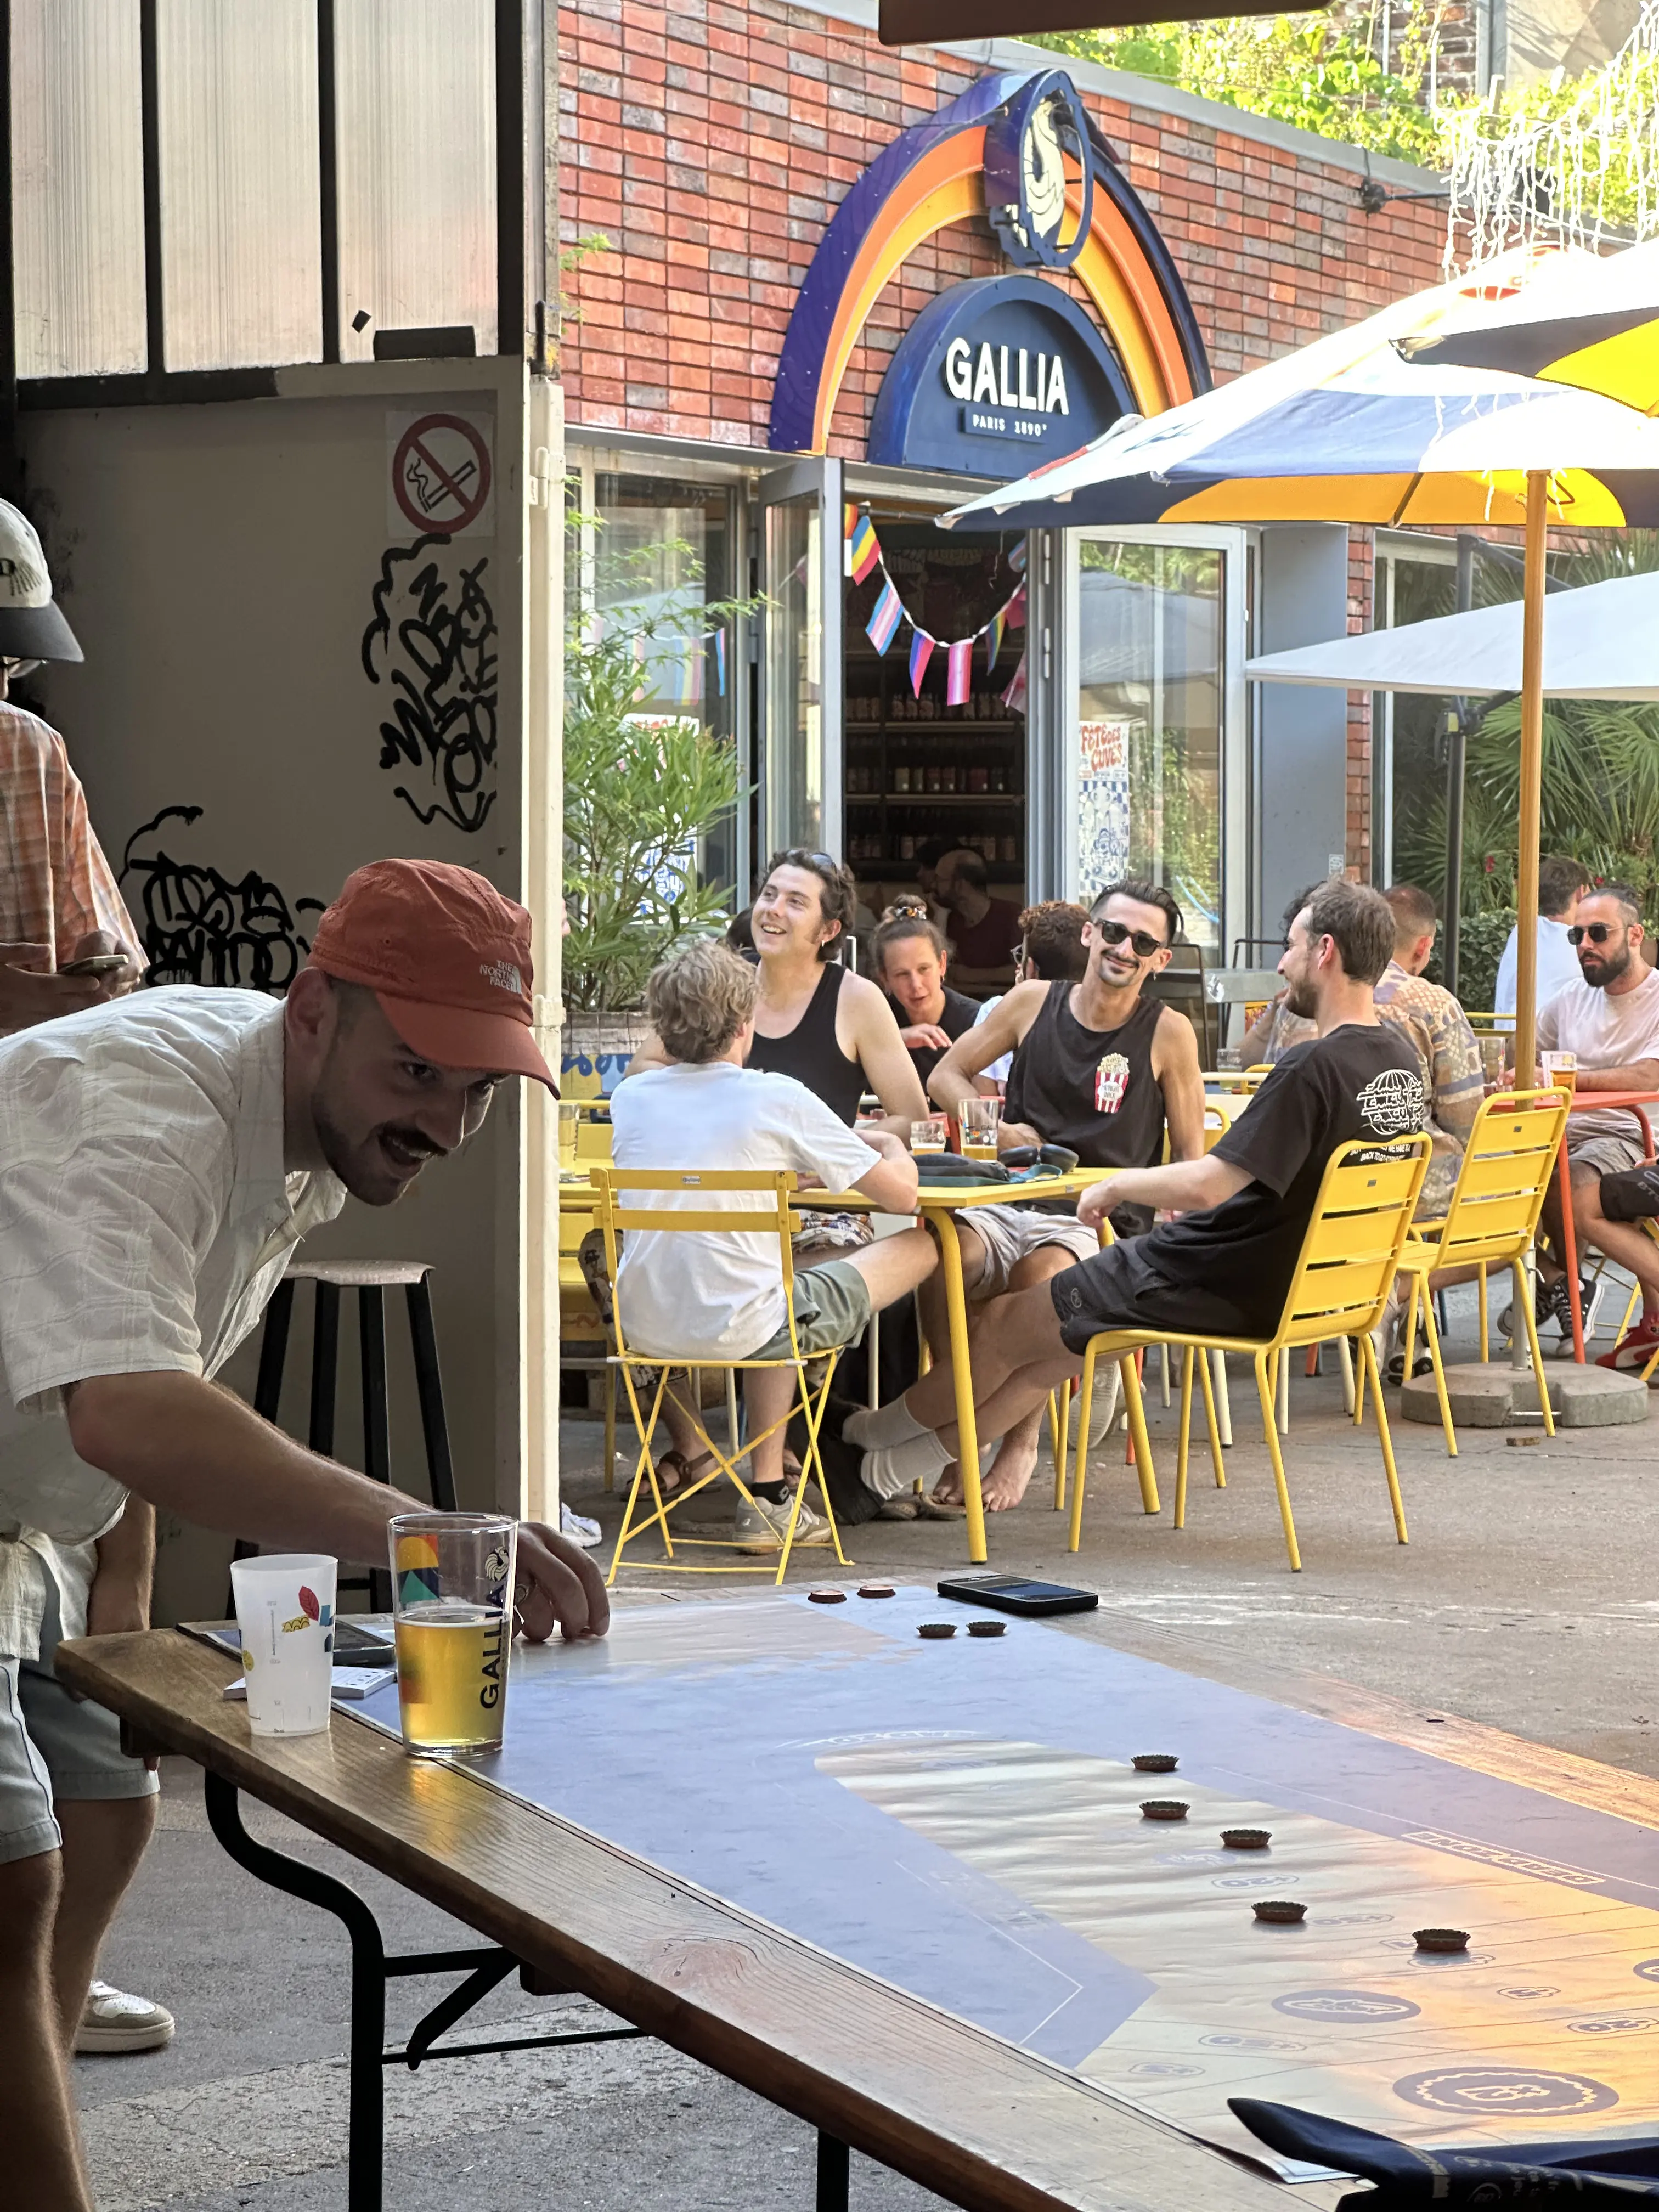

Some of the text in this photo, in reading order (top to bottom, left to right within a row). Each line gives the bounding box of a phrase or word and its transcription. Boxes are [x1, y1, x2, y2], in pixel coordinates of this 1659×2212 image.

[945, 337, 1069, 415] GALLIA
[972, 414, 1006, 432] PARIS
[479, 964, 514, 982] NORTH
[497, 960, 513, 972] THE
[490, 977, 511, 990] FACE
[480, 1585, 504, 1709] GALLIA
[1403, 1831, 1604, 1884] DEADZONE
[1218, 1876, 1292, 1888] +20
